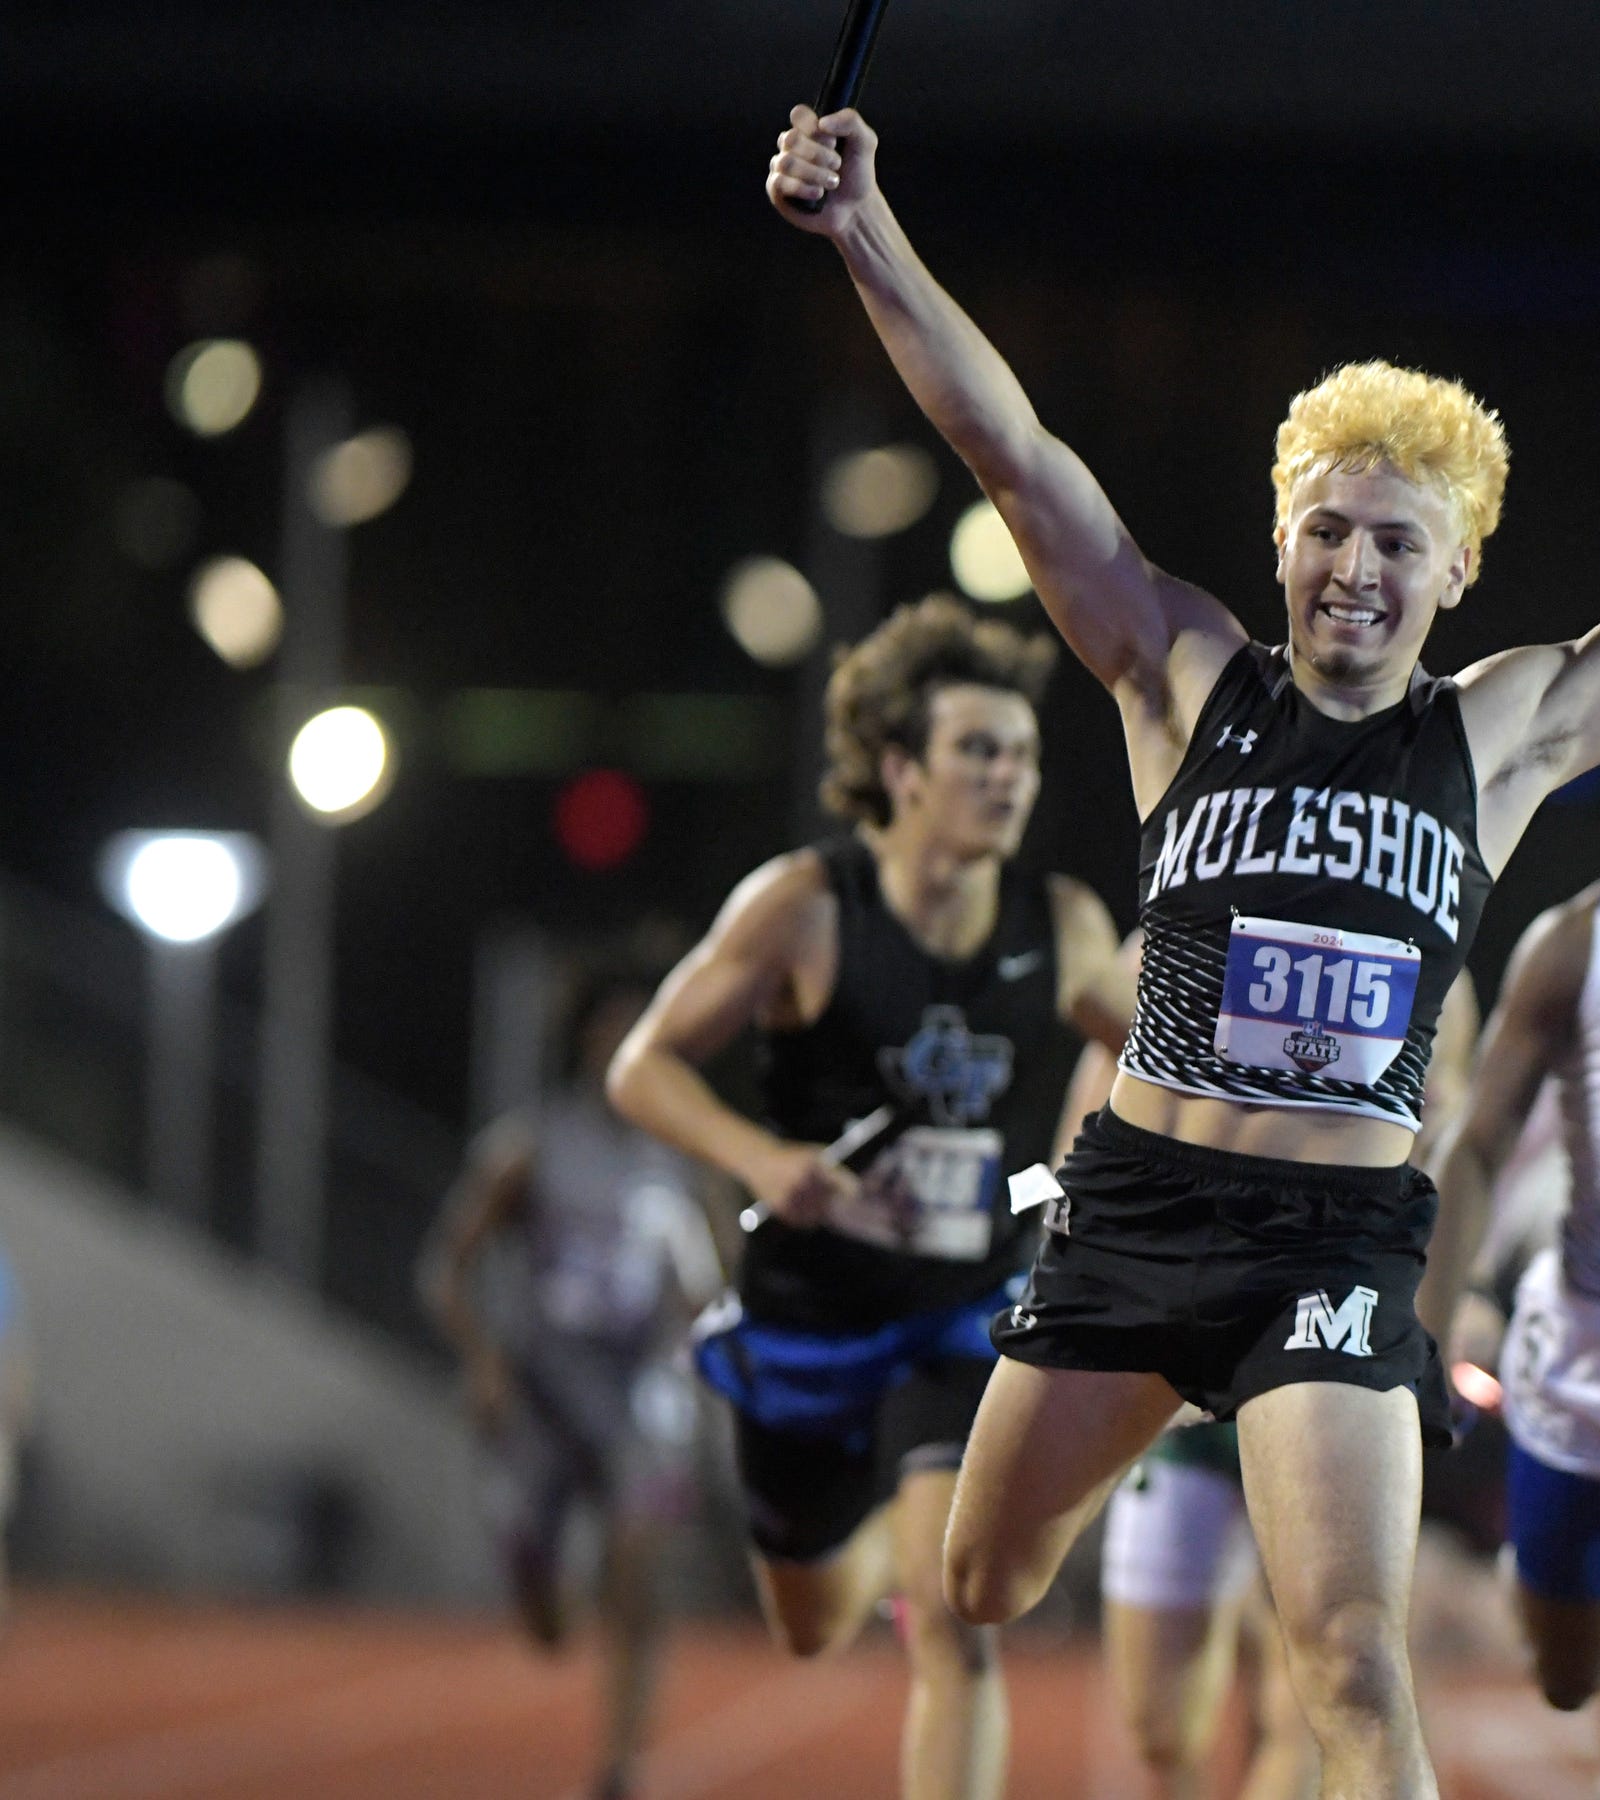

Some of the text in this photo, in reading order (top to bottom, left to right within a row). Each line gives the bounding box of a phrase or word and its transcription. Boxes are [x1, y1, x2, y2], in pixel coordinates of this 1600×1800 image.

[1148, 787, 1465, 944] MULESHOE
[1248, 946, 1392, 1029] 3115
[1284, 1039, 1340, 1060] STATE
[1284, 1285, 1378, 1356] M
